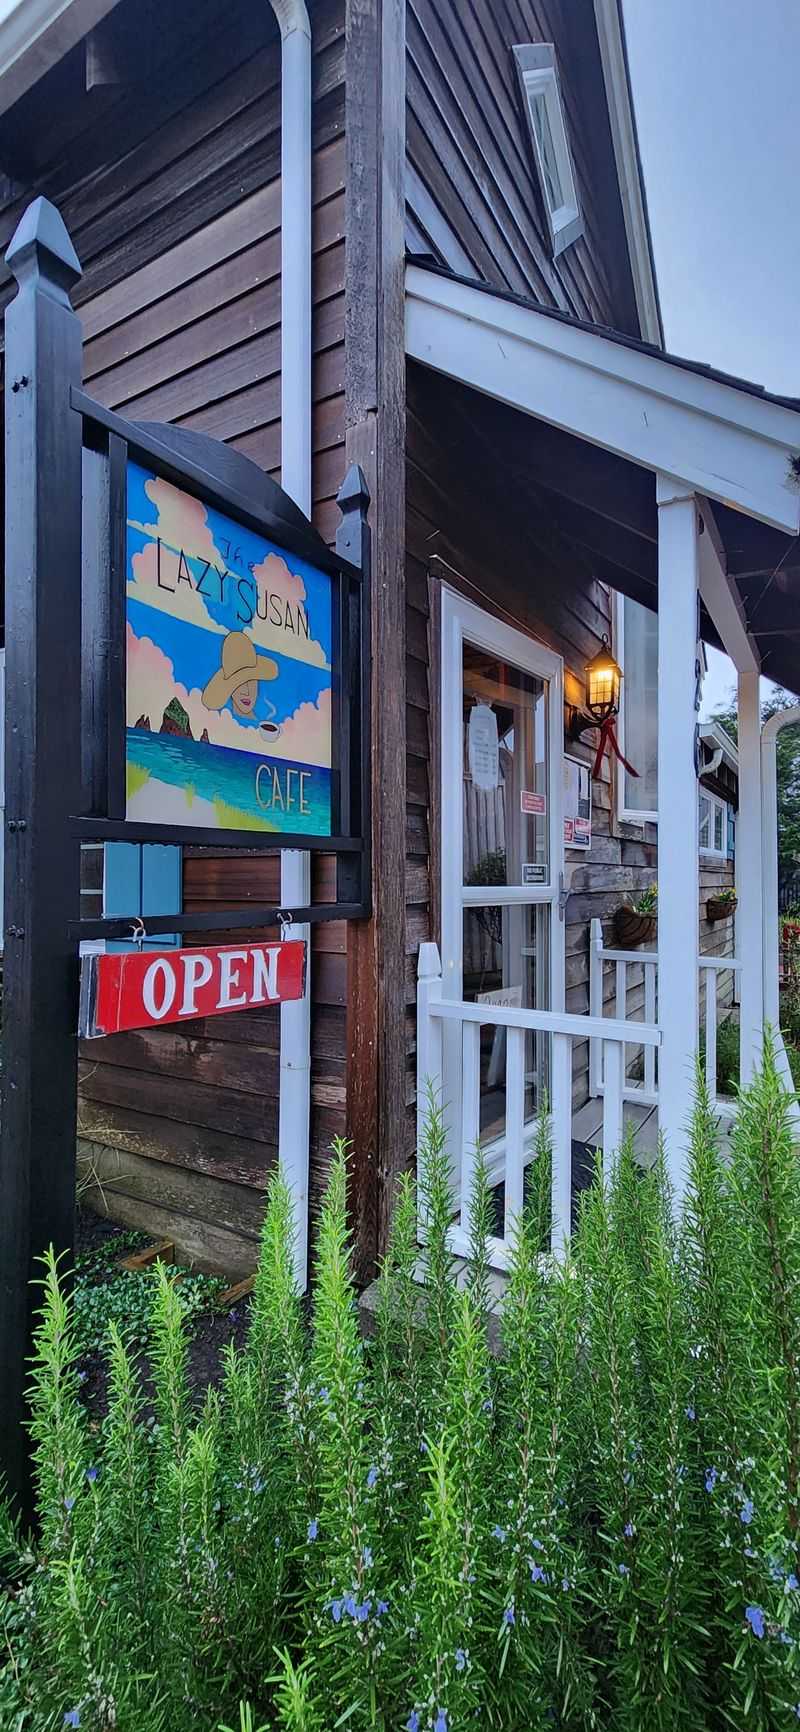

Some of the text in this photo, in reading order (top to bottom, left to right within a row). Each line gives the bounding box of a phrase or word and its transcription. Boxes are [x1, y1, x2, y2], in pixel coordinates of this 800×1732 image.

[219, 536, 255, 573] The
[156, 537, 309, 640] LAZY SUSAN
[255, 763, 312, 815] CAFE
[142, 947, 282, 1020] OPEN
